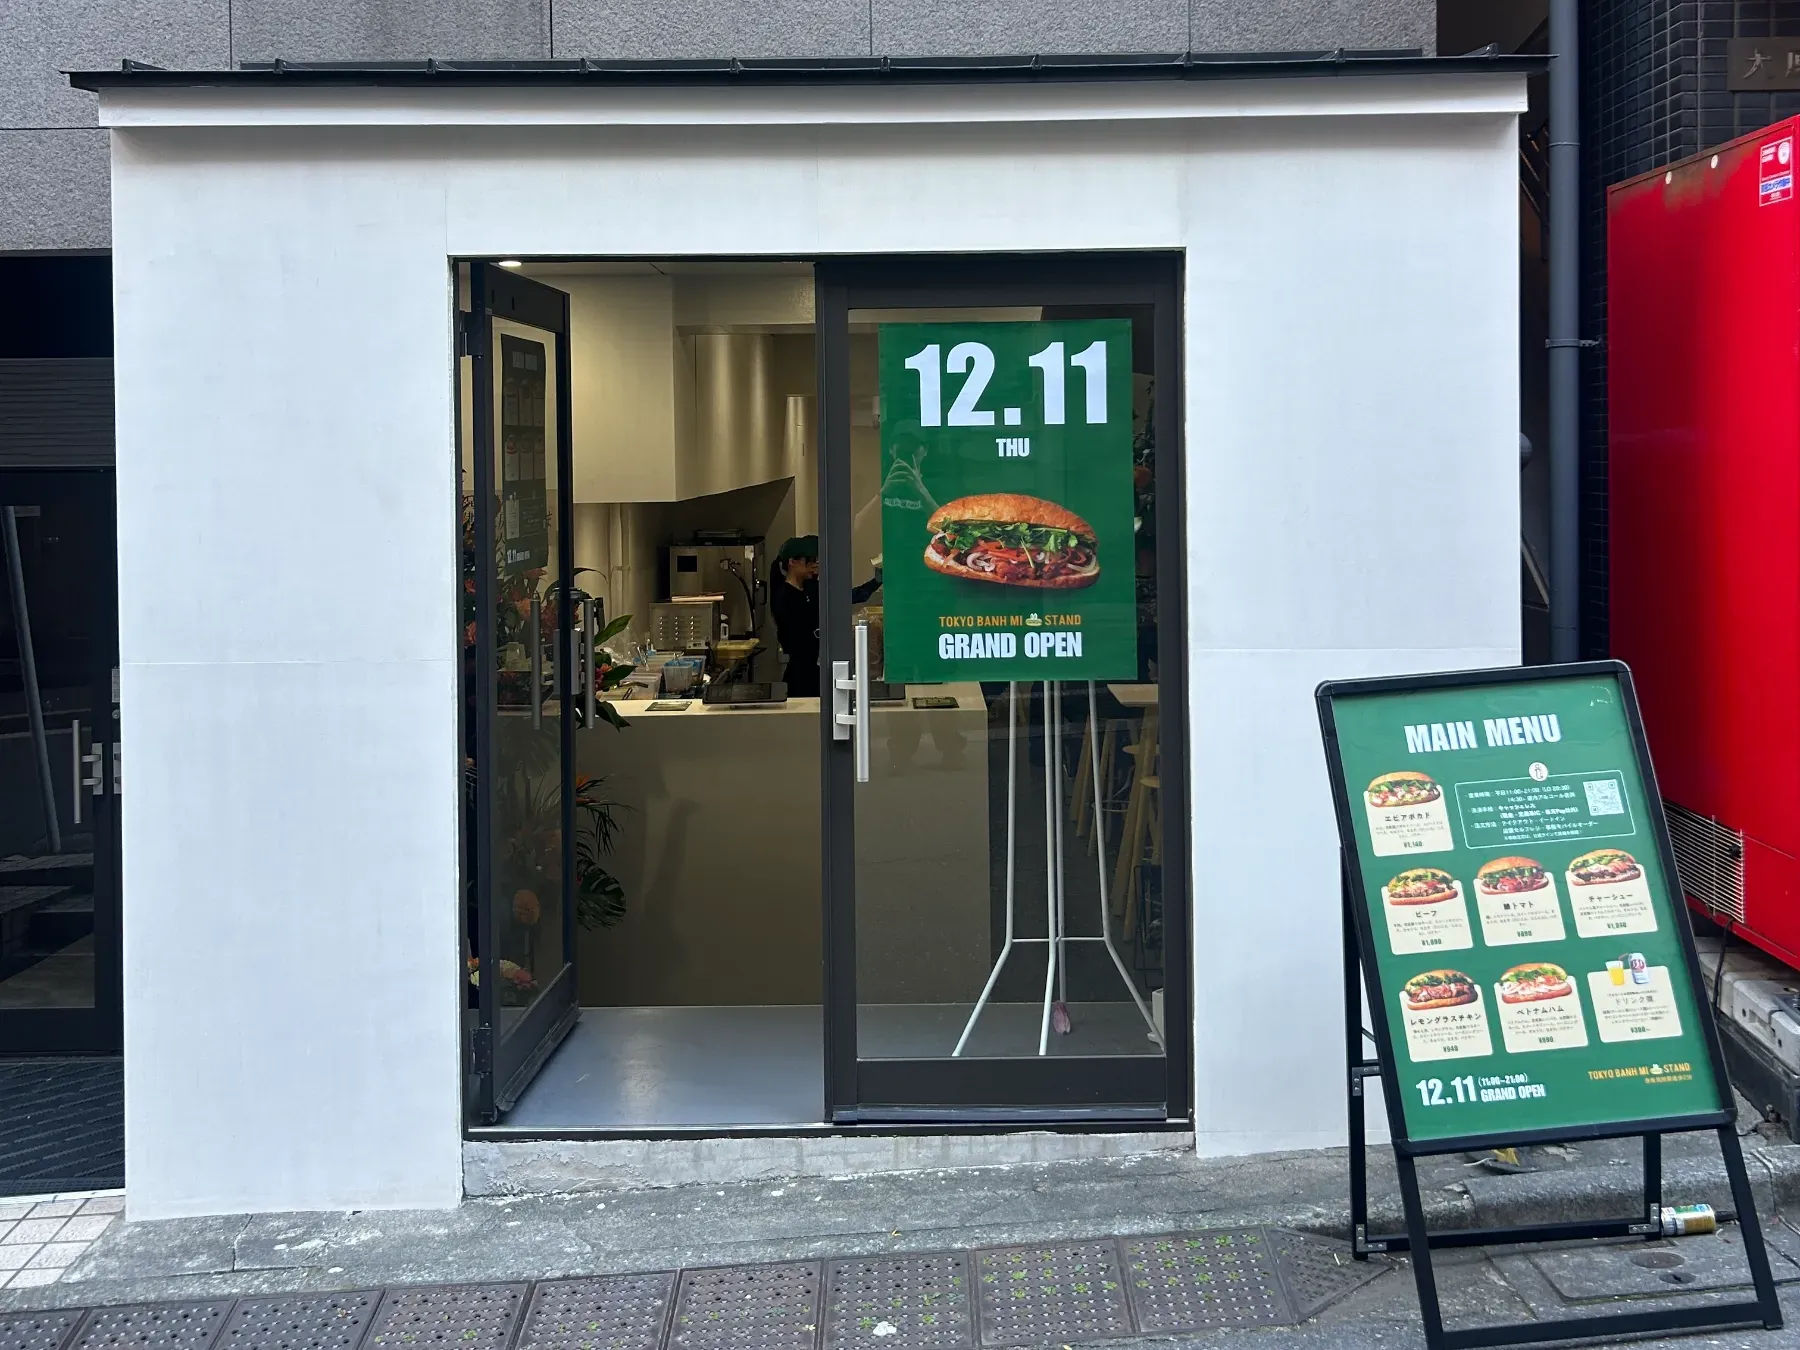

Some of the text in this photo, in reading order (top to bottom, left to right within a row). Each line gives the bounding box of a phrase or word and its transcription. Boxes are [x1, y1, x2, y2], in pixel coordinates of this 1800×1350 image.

[905, 341, 1108, 427] 12.11
[995, 438, 1031, 458] THU
[939, 614, 1082, 628] TOKYO BANH MI STAND
[938, 632, 1083, 660] GRAND OPEN
[1404, 713, 1563, 754] MAIN MENU
[1385, 812, 1431, 822] エビアボカド
[1588, 893, 1633, 902] チャーシュー
[1415, 910, 1437, 918] ビーフ
[1410, 1013, 1482, 1026] レモングラスチキン
[1516, 1005, 1565, 1016] ベトナムハム
[1588, 1062, 1691, 1081] TOKYO BANH MI STAND
[1415, 1075, 1477, 1106] 12.11
[1480, 1083, 1546, 1103] GRAND OPEN
